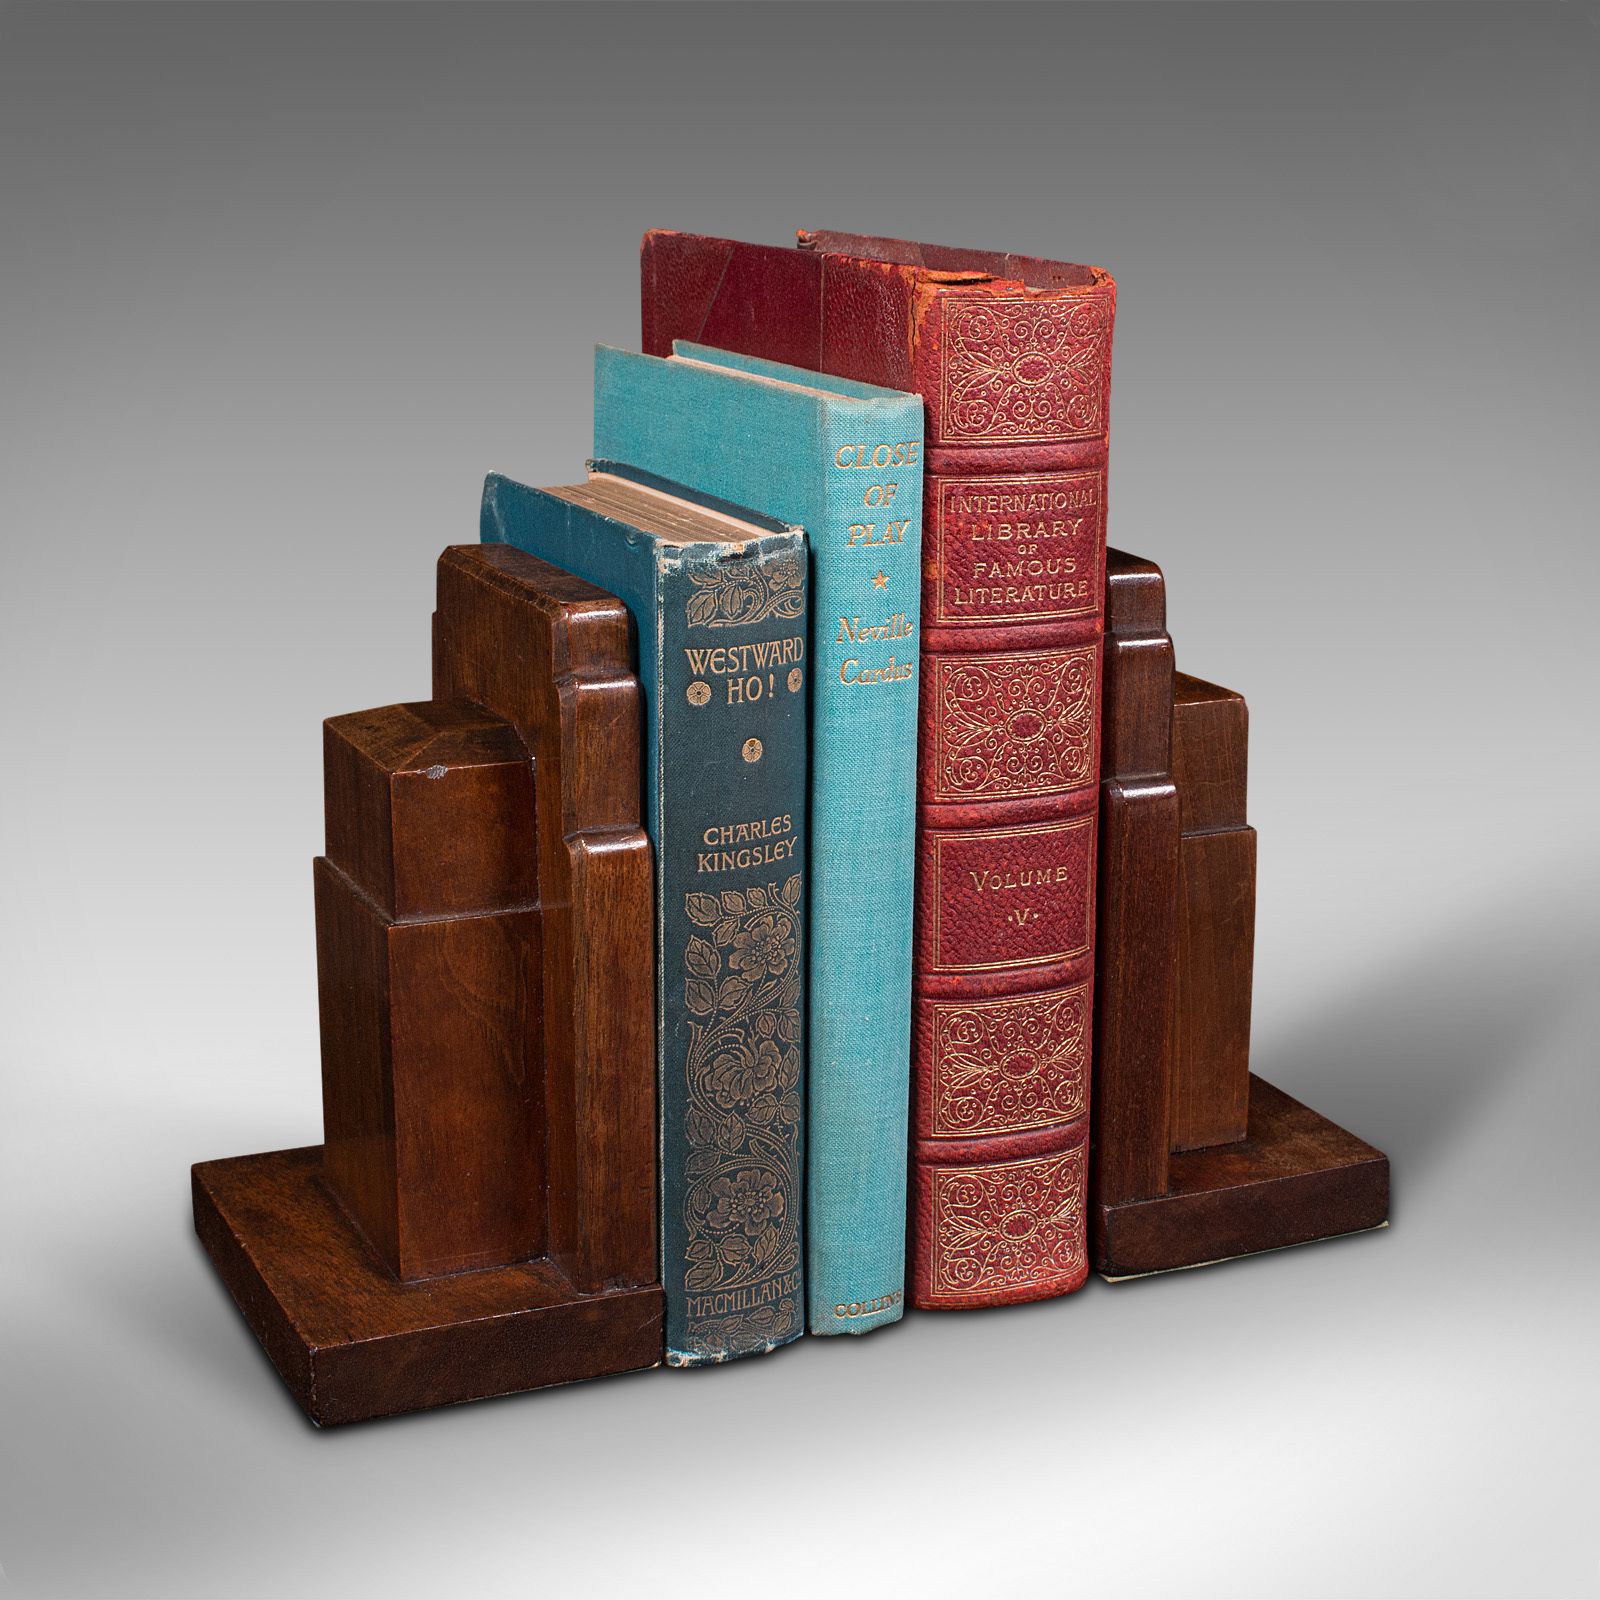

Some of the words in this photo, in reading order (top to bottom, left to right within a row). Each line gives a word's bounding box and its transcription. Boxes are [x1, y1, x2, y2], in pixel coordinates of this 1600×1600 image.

[835, 441, 920, 469] CLOSE
[863, 483, 898, 508] OF
[951, 489, 1097, 513] INTERNATIONAL
[846, 519, 911, 547] PLAY
[972, 518, 1083, 541] LIBRARY
[1017, 544, 1038, 555] OF
[973, 557, 1076, 579] FAMOUS
[954, 580, 1088, 605] LITERATURE
[836, 612, 913, 643] Neville
[684, 636, 804, 676] WESTWARD
[839, 656, 913, 685] Cardus
[727, 673, 775, 705] HO!
[703, 814, 792, 846] CHARLES
[697, 836, 798, 873] KINGSLEY
